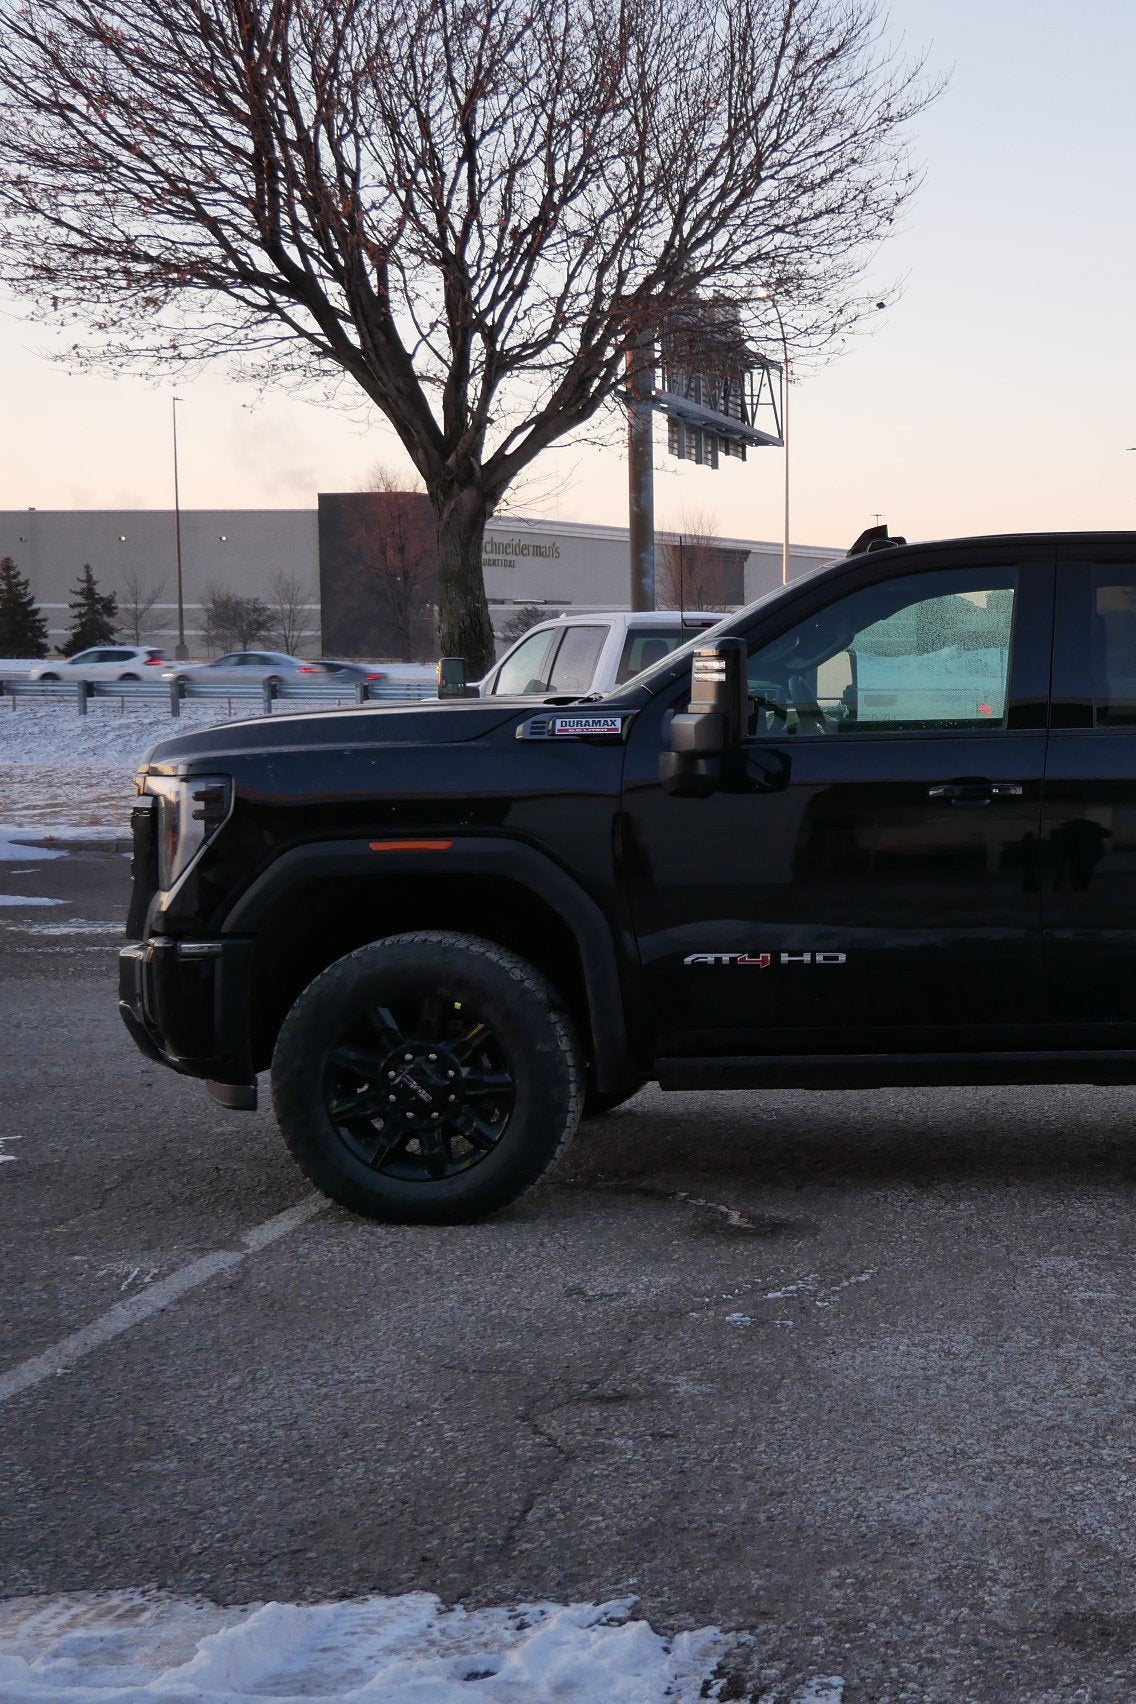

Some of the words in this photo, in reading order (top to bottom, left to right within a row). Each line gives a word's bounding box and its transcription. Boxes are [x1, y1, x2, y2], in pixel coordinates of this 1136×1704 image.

[484, 537, 560, 559] chneiderman's
[482, 558, 516, 568] URNITURE
[560, 719, 617, 728] DURAMAX
[683, 953, 771, 968] AT4
[780, 953, 847, 964] HD
